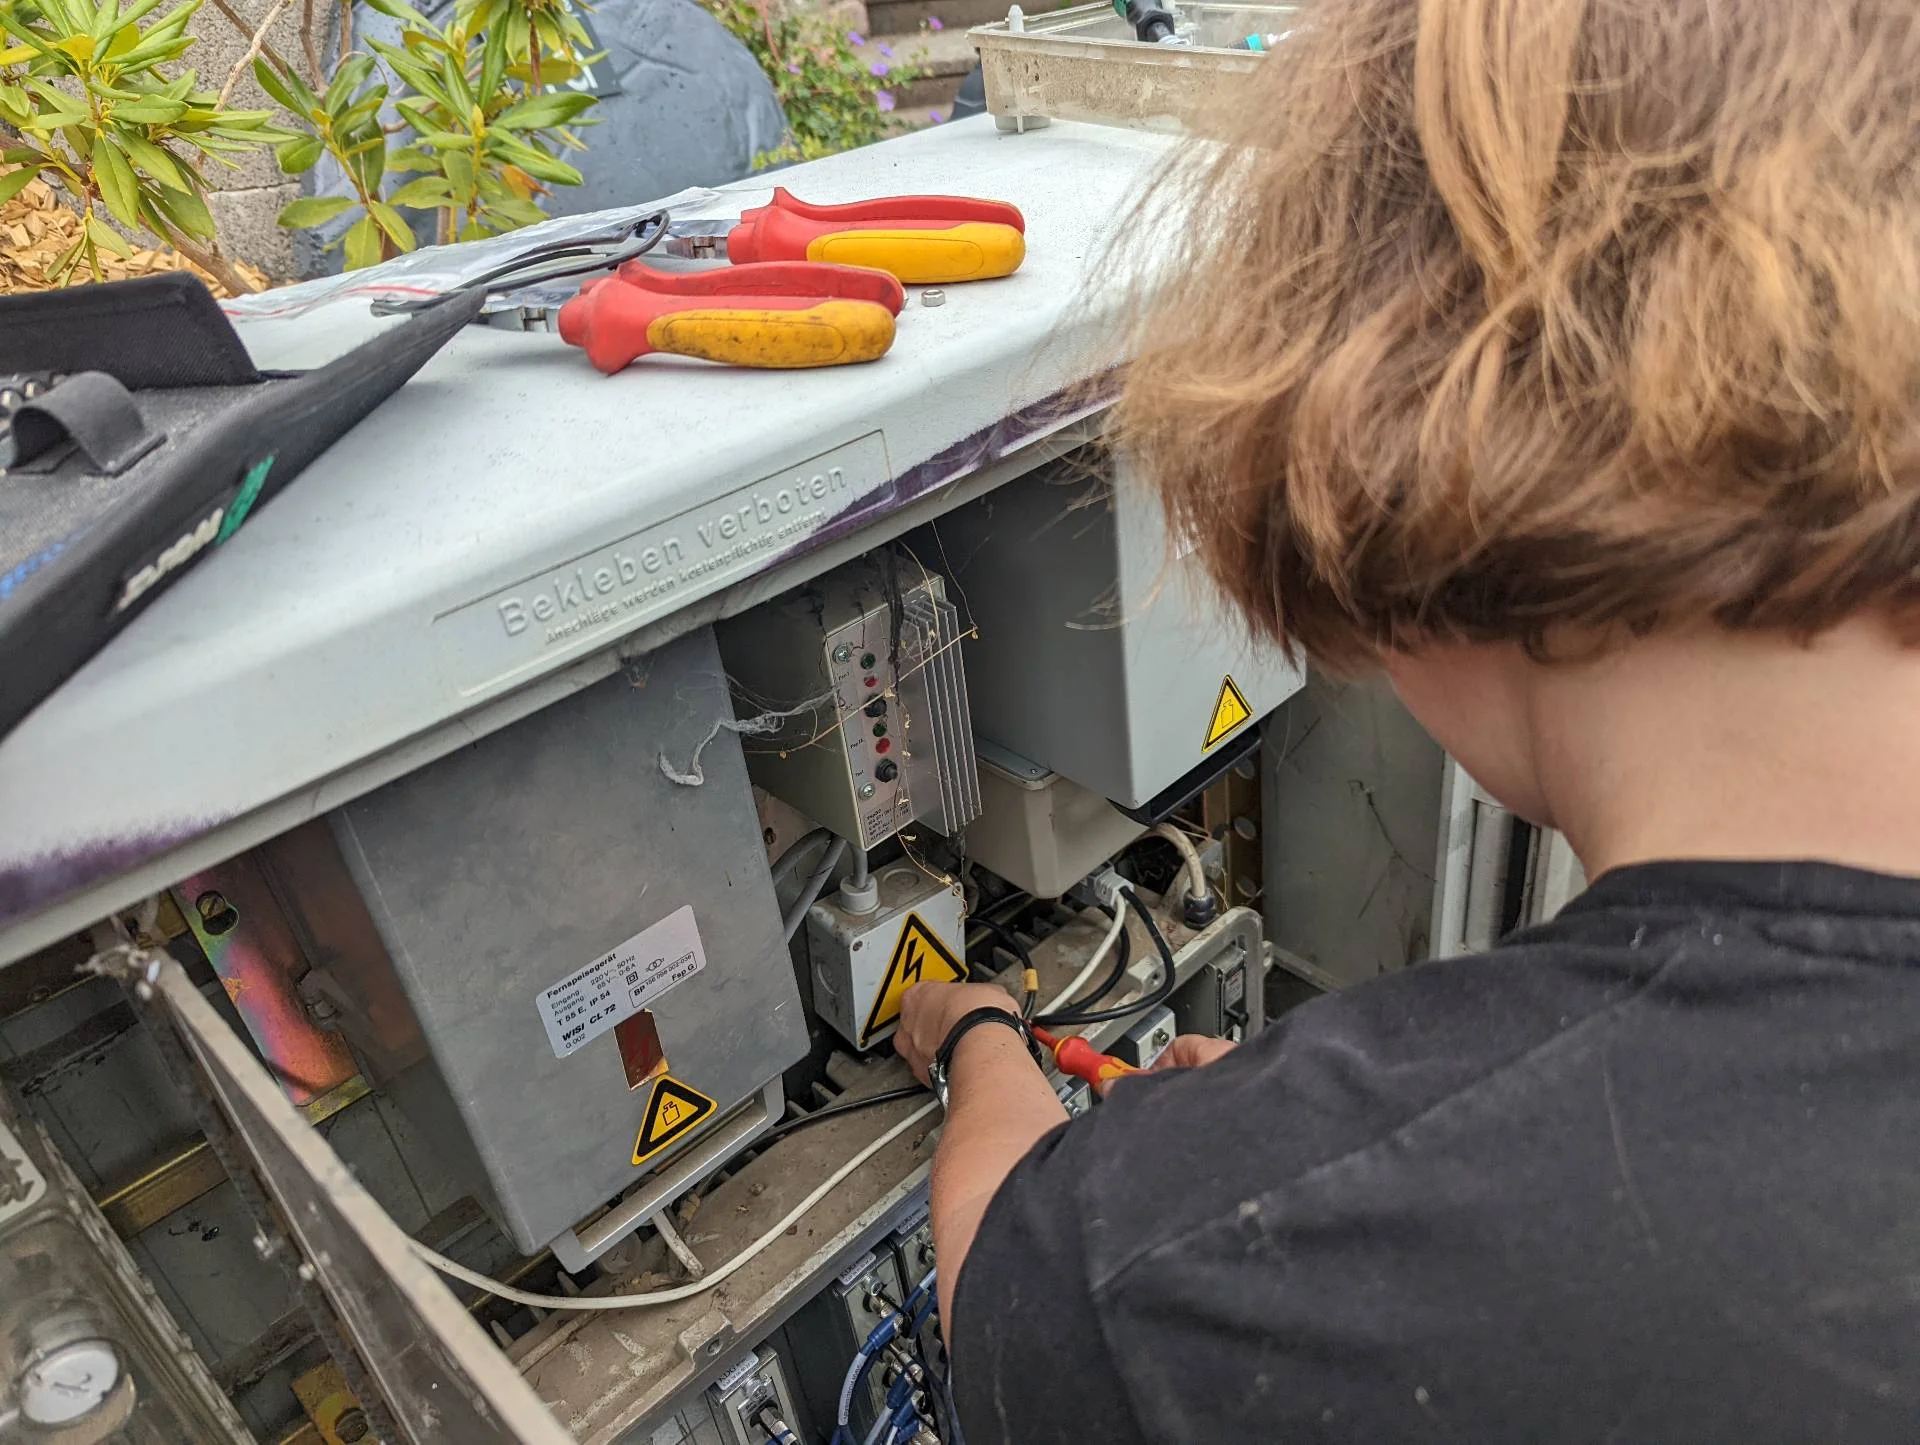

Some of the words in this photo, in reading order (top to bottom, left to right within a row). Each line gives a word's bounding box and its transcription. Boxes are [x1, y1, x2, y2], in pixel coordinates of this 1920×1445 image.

[496, 534, 684, 637] Bekleben
[696, 465, 848, 551] verboten
[547, 953, 617, 999] Fernspeisegerät
[590, 974, 603, 985] 220
[556, 1018, 563, 1026] T
[589, 997, 598, 1007] IP
[600, 990, 611, 1000] 54
[561, 1022, 585, 1042] WISI
[589, 1013, 603, 1025] CL
[604, 1003, 617, 1015] 72
